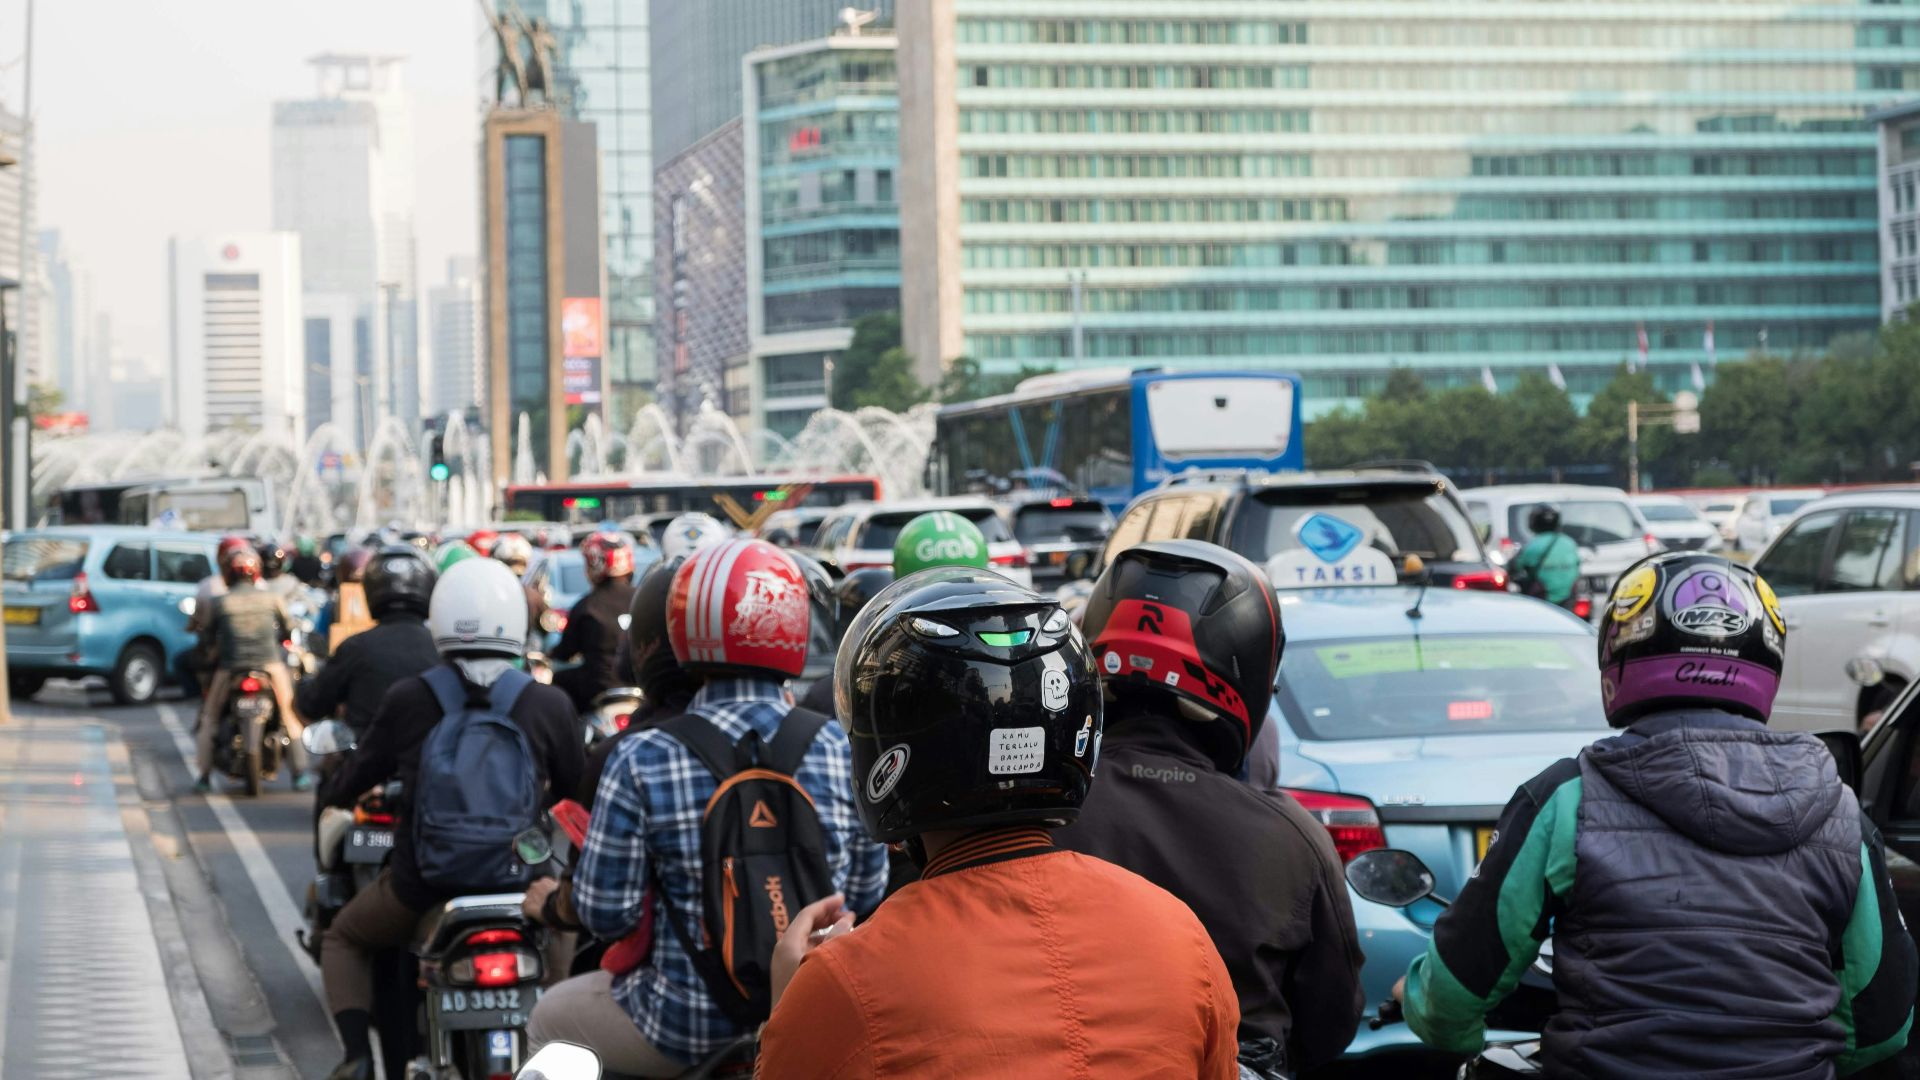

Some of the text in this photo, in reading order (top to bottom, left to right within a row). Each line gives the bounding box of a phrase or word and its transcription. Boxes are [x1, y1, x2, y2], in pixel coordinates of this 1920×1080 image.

[915, 533, 978, 562] Grab
[1296, 566, 1377, 581] TAKSI
[1680, 646, 1740, 657] connect the LINE
[1002, 732, 1029, 740] KAMU
[999, 742, 1038, 751] TERLALU
[1000, 753, 1035, 761] BANYAK
[1132, 764, 1196, 783] Respiro
[441, 990, 467, 1011] AD
